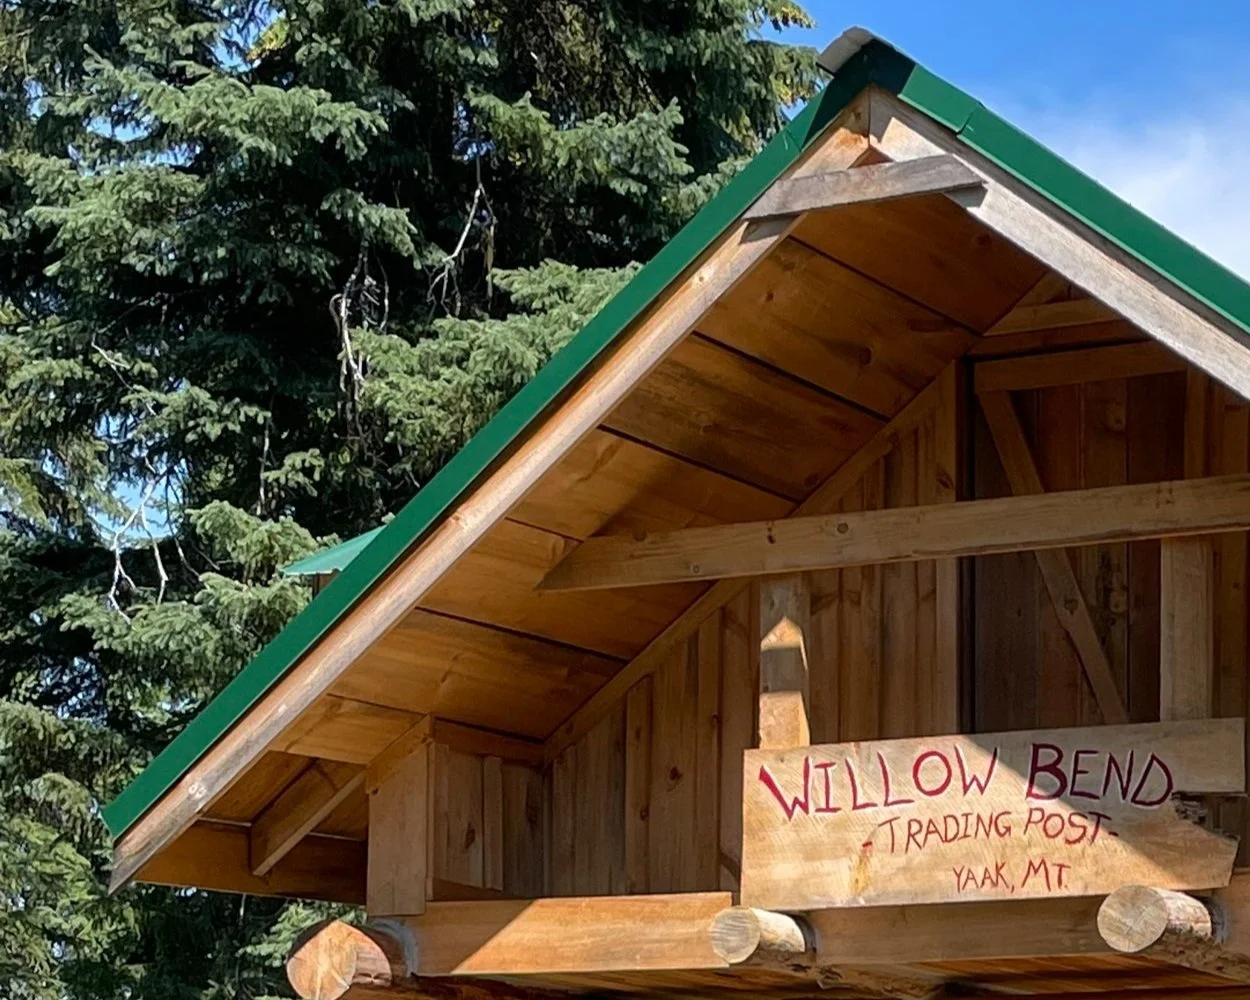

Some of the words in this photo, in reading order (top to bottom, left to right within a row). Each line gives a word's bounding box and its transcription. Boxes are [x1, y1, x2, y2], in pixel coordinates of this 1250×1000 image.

[758, 745, 998, 821] WILLOW
[1025, 743, 1174, 807] BEND
[952, 861, 1015, 893] YAAK,
